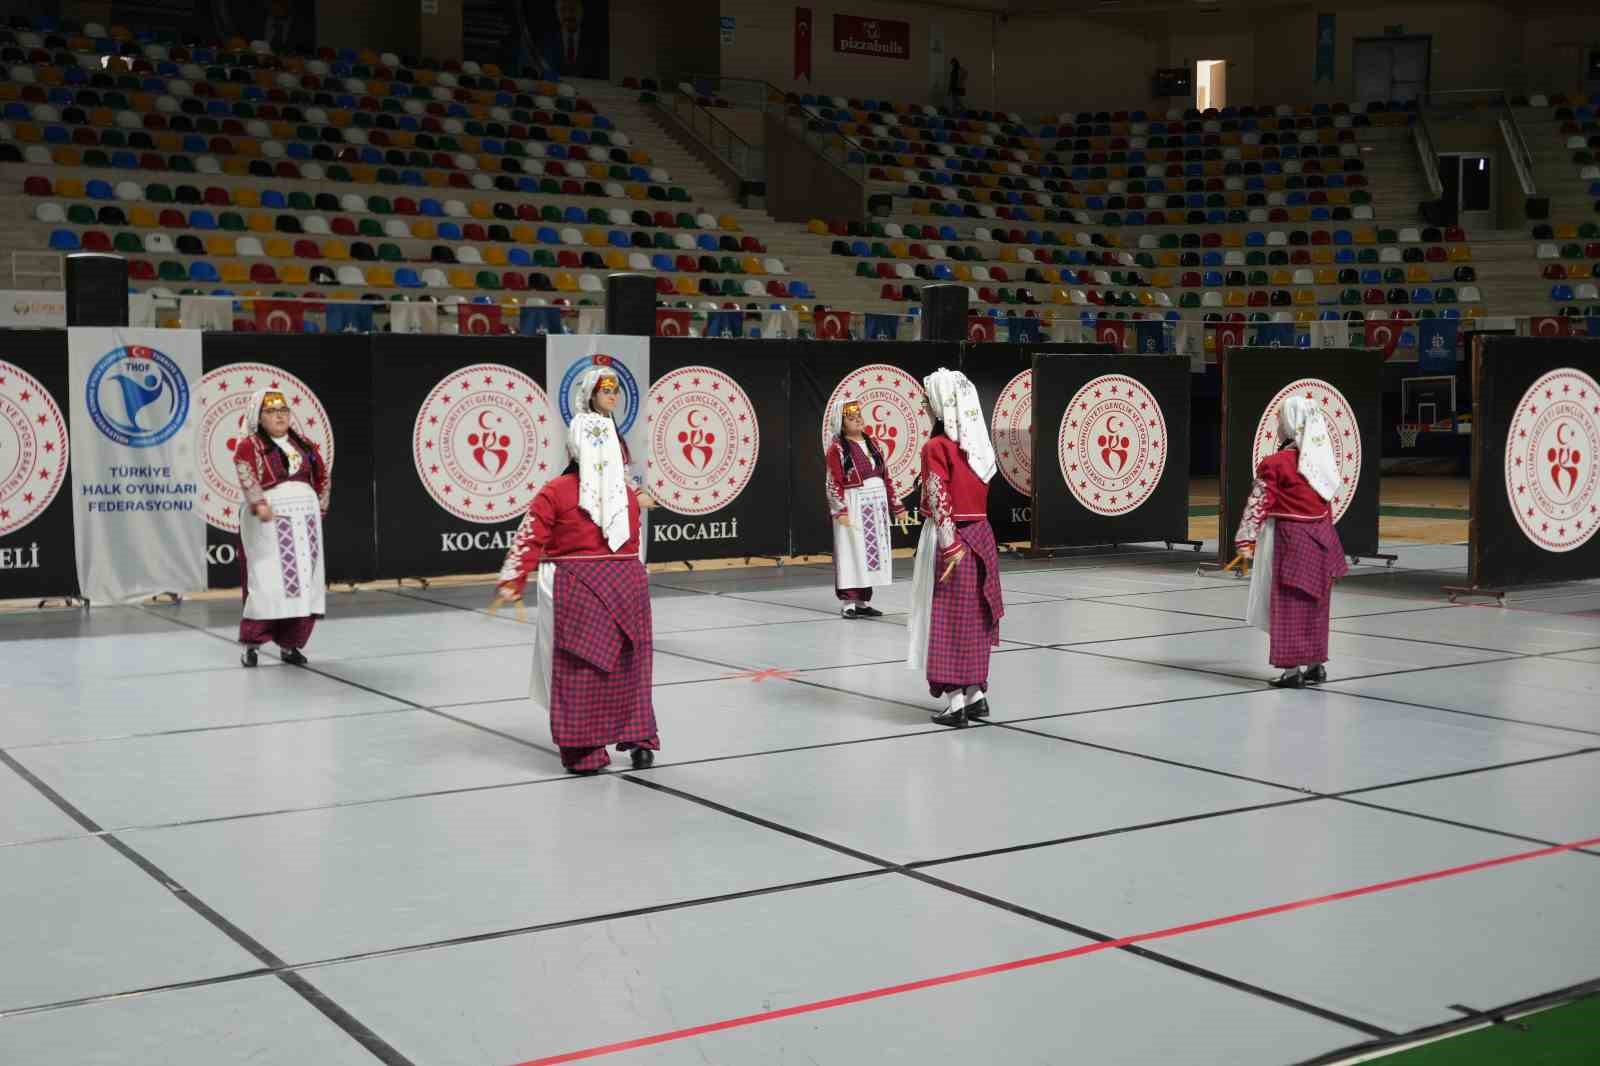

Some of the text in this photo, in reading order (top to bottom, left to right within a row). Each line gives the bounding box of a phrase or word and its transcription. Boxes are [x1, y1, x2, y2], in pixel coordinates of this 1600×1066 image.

[840, 37, 904, 54] pizzabulls
[110, 466, 171, 478] TÜRKİYE
[83, 483, 197, 495] HALK OYUNLARI
[88, 500, 193, 512] FEDERASYONU
[653, 517, 738, 542] KOCAELİ
